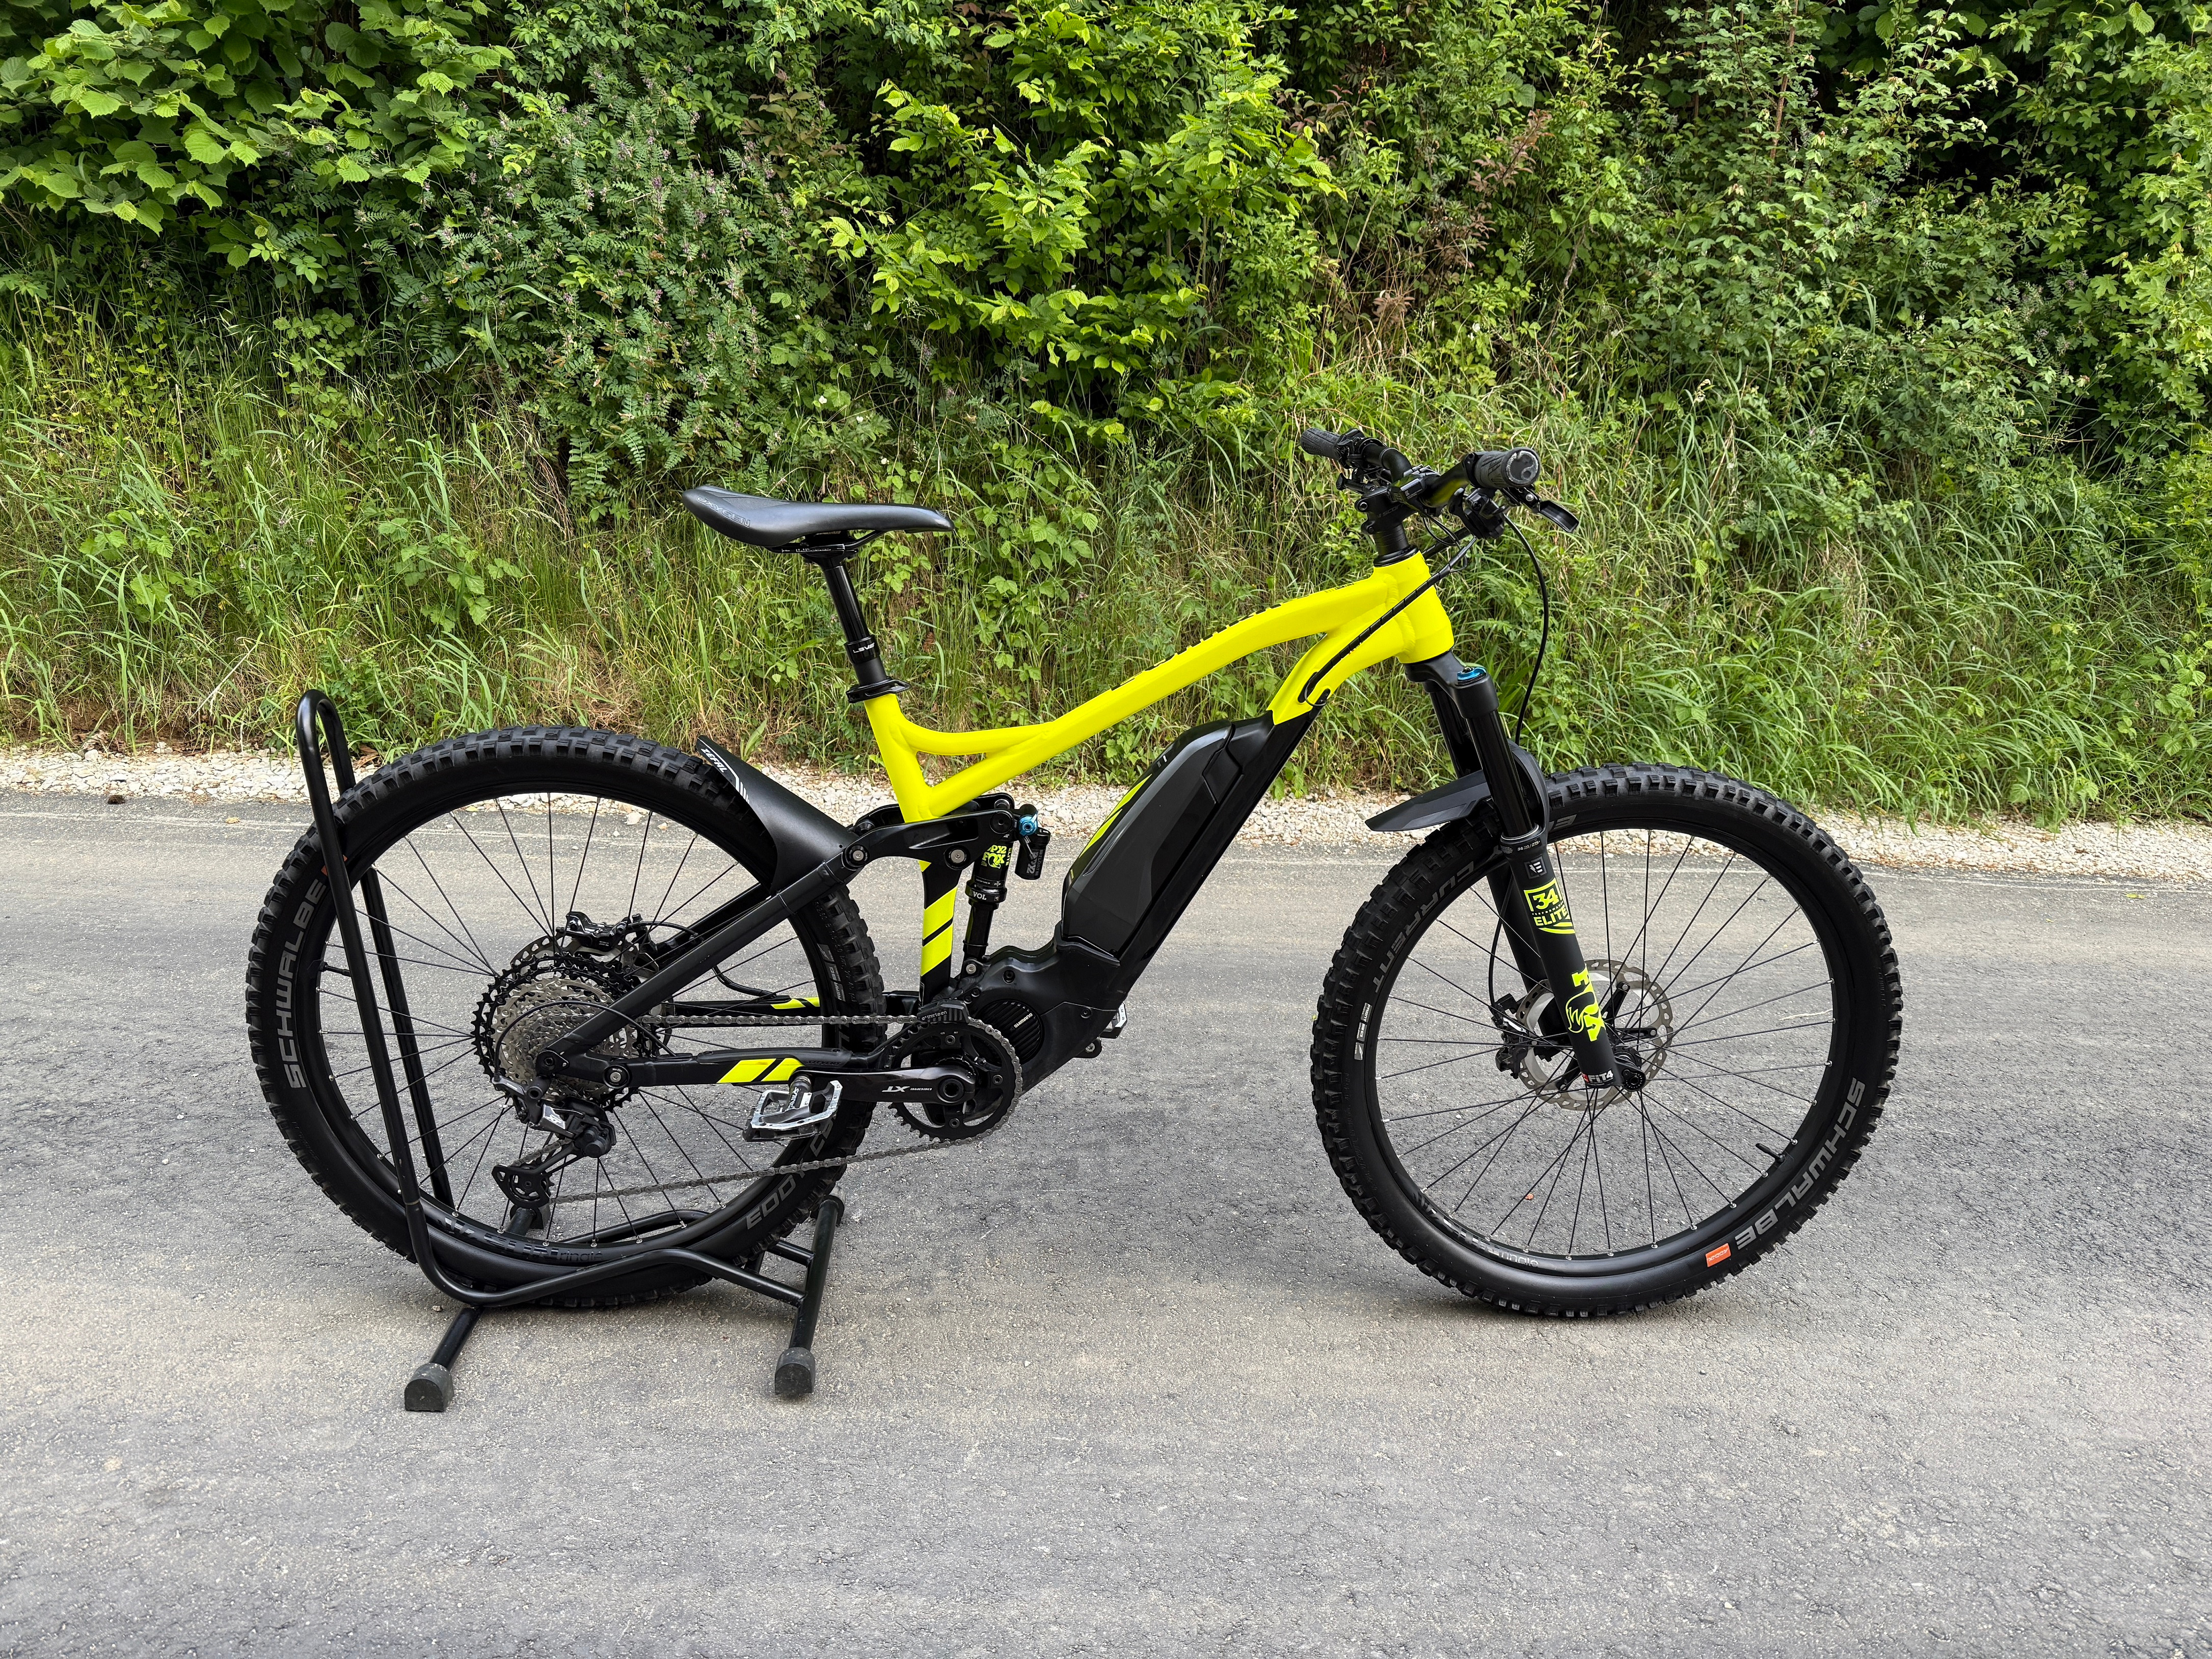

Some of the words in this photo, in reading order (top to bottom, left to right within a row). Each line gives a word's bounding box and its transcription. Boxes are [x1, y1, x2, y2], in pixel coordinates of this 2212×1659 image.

[696, 495, 751, 528] OXYGEN
[700, 748, 727, 773] ZEFAL
[982, 851, 1006, 869] FOX
[1532, 888, 1559, 909] 34
[1372, 861, 1474, 993] CURRENT
[1533, 904, 1568, 926] ELITE
[276, 878, 327, 1088] SCHWALBE
[1013, 1012, 1033, 1028] SHIMANO
[1735, 1077, 1866, 1250] SCHWALBE
